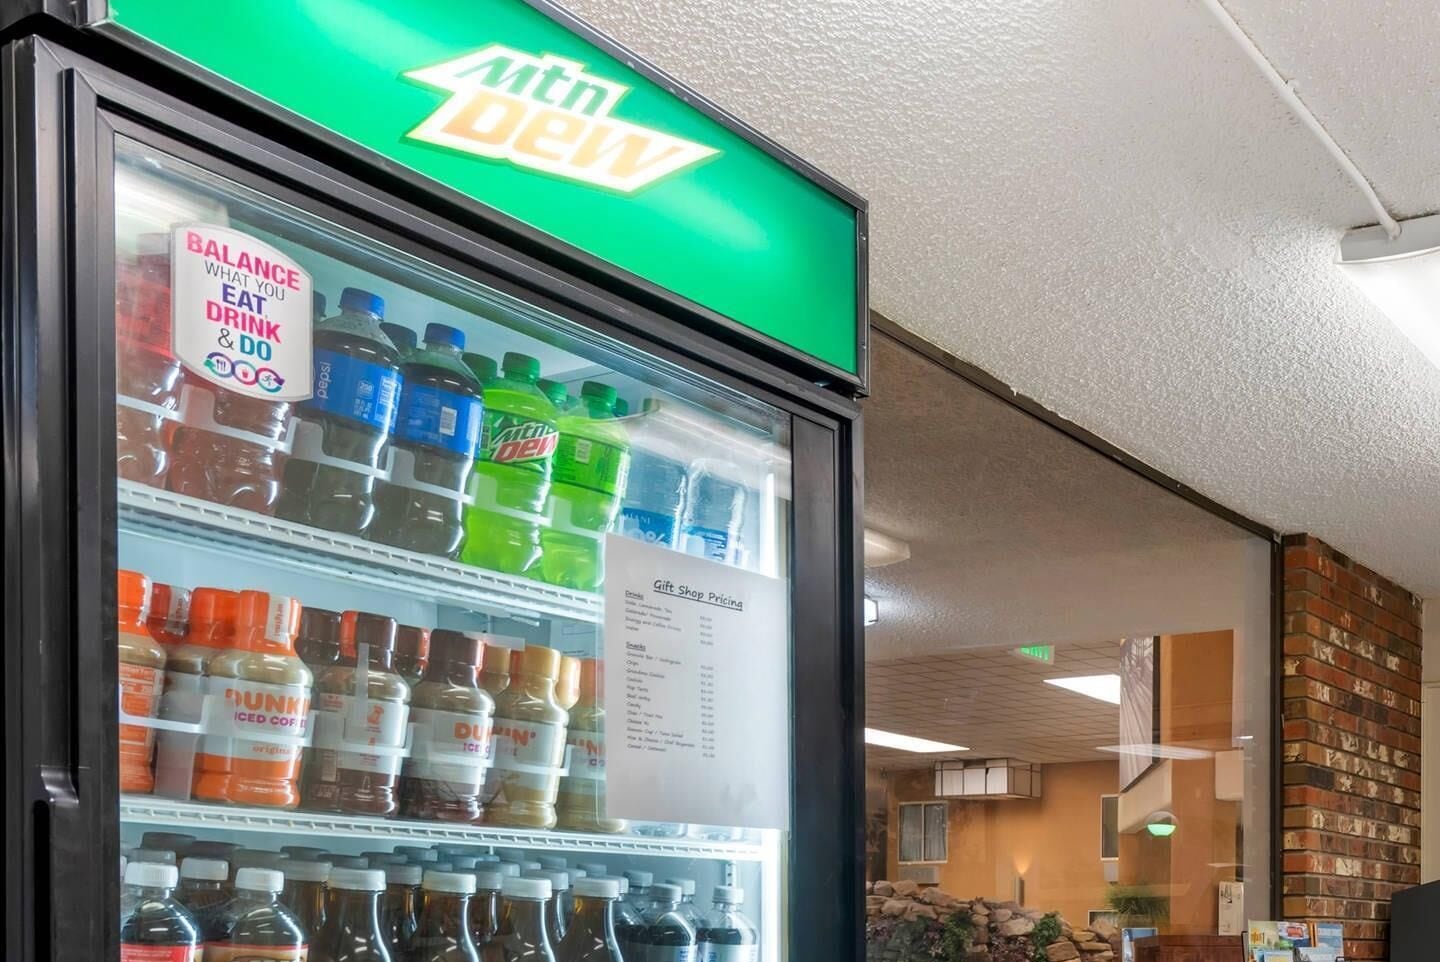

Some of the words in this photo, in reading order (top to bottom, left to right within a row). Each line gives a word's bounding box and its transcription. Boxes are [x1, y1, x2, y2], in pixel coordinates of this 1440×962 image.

[454, 54, 610, 117] Mtn
[187, 231, 301, 291] BALANCE
[205, 260, 250, 288] WHAT
[256, 278, 285, 301] YOU
[206, 300, 282, 344] DRINK
[218, 328, 234, 350] &
[240, 334, 272, 361] DO
[317, 362, 331, 399] pepsi
[653, 579, 675, 592] Gift
[678, 585, 704, 600] Shop
[708, 592, 743, 608] Pricing
